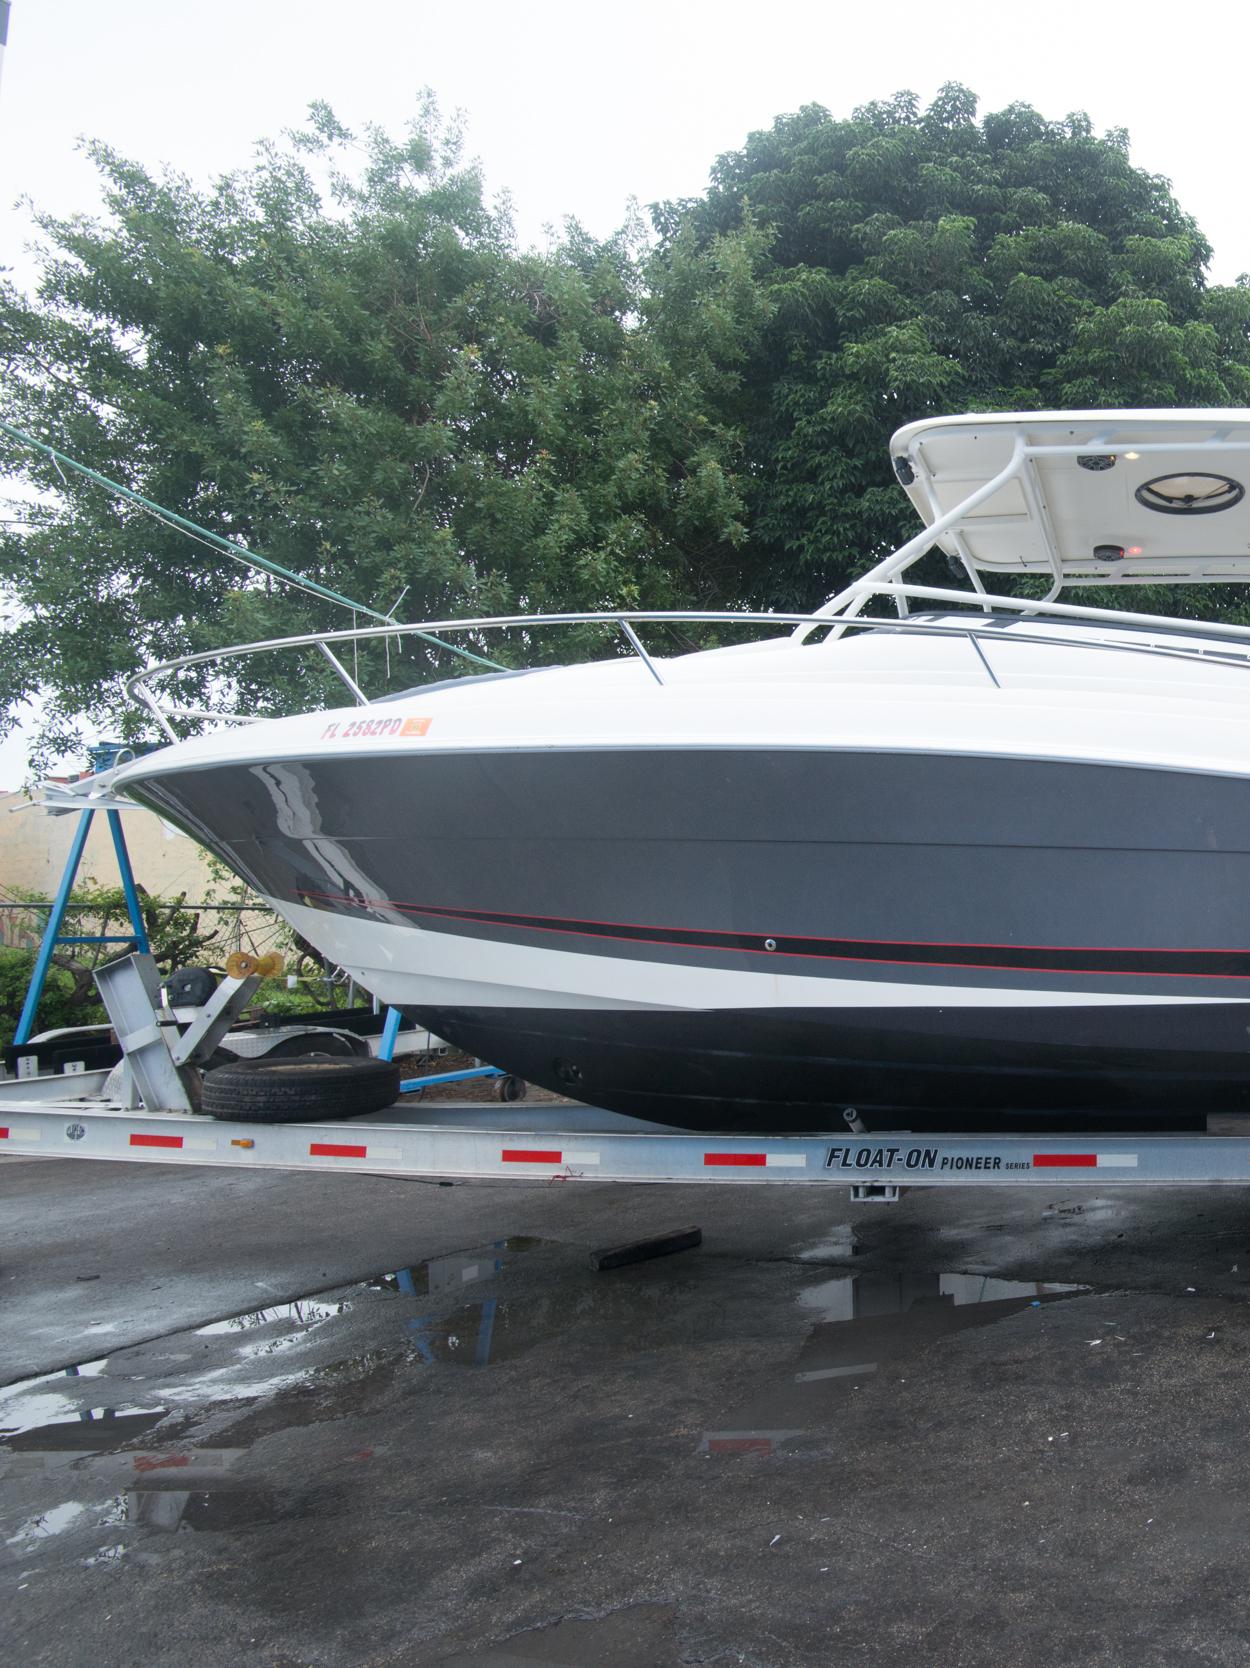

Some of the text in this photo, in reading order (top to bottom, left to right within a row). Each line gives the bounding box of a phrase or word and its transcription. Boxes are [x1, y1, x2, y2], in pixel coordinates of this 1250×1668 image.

[320, 722, 341, 739] FL
[826, 1147, 1030, 1170] FLOAT-ON PIONEER SERIES
